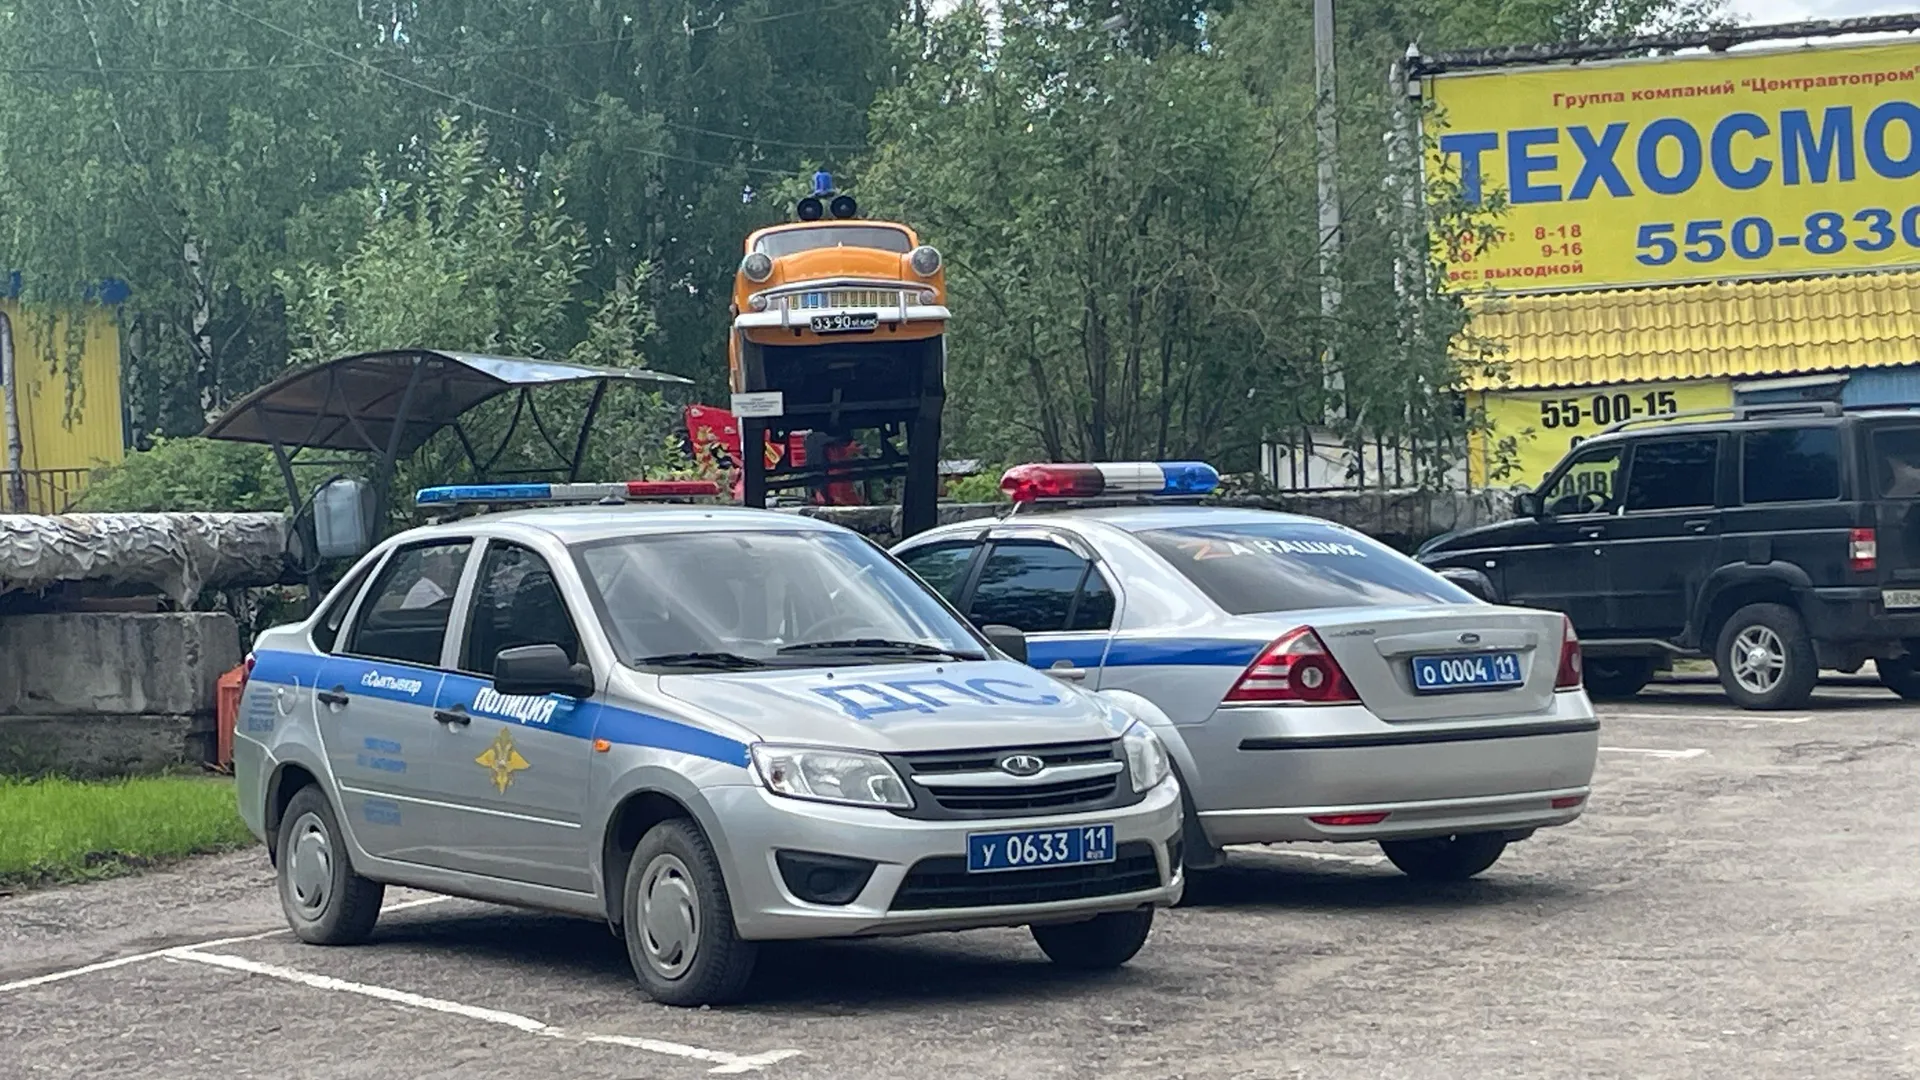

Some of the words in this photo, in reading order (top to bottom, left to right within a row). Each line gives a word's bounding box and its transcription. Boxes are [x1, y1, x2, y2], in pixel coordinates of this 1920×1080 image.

[1553, 91, 1625, 109] Группа
[1631, 80, 1735, 102] компаний
[1534, 224, 1582, 240] 8-18
[1541, 242, 1583, 258] 9-16
[1484, 260, 1583, 279] выходной
[1541, 391, 1677, 428] 55-00-15
[1254, 540, 1368, 558] НАШИХ
[1440, 658, 1488, 683] 0004
[1496, 655, 1515, 673] 11
[473, 687, 557, 724] ПОЛИЦИЯ
[809, 679, 1061, 720] ДПС
[1007, 832, 1068, 865] 0633
[1085, 827, 1107, 850] 11
